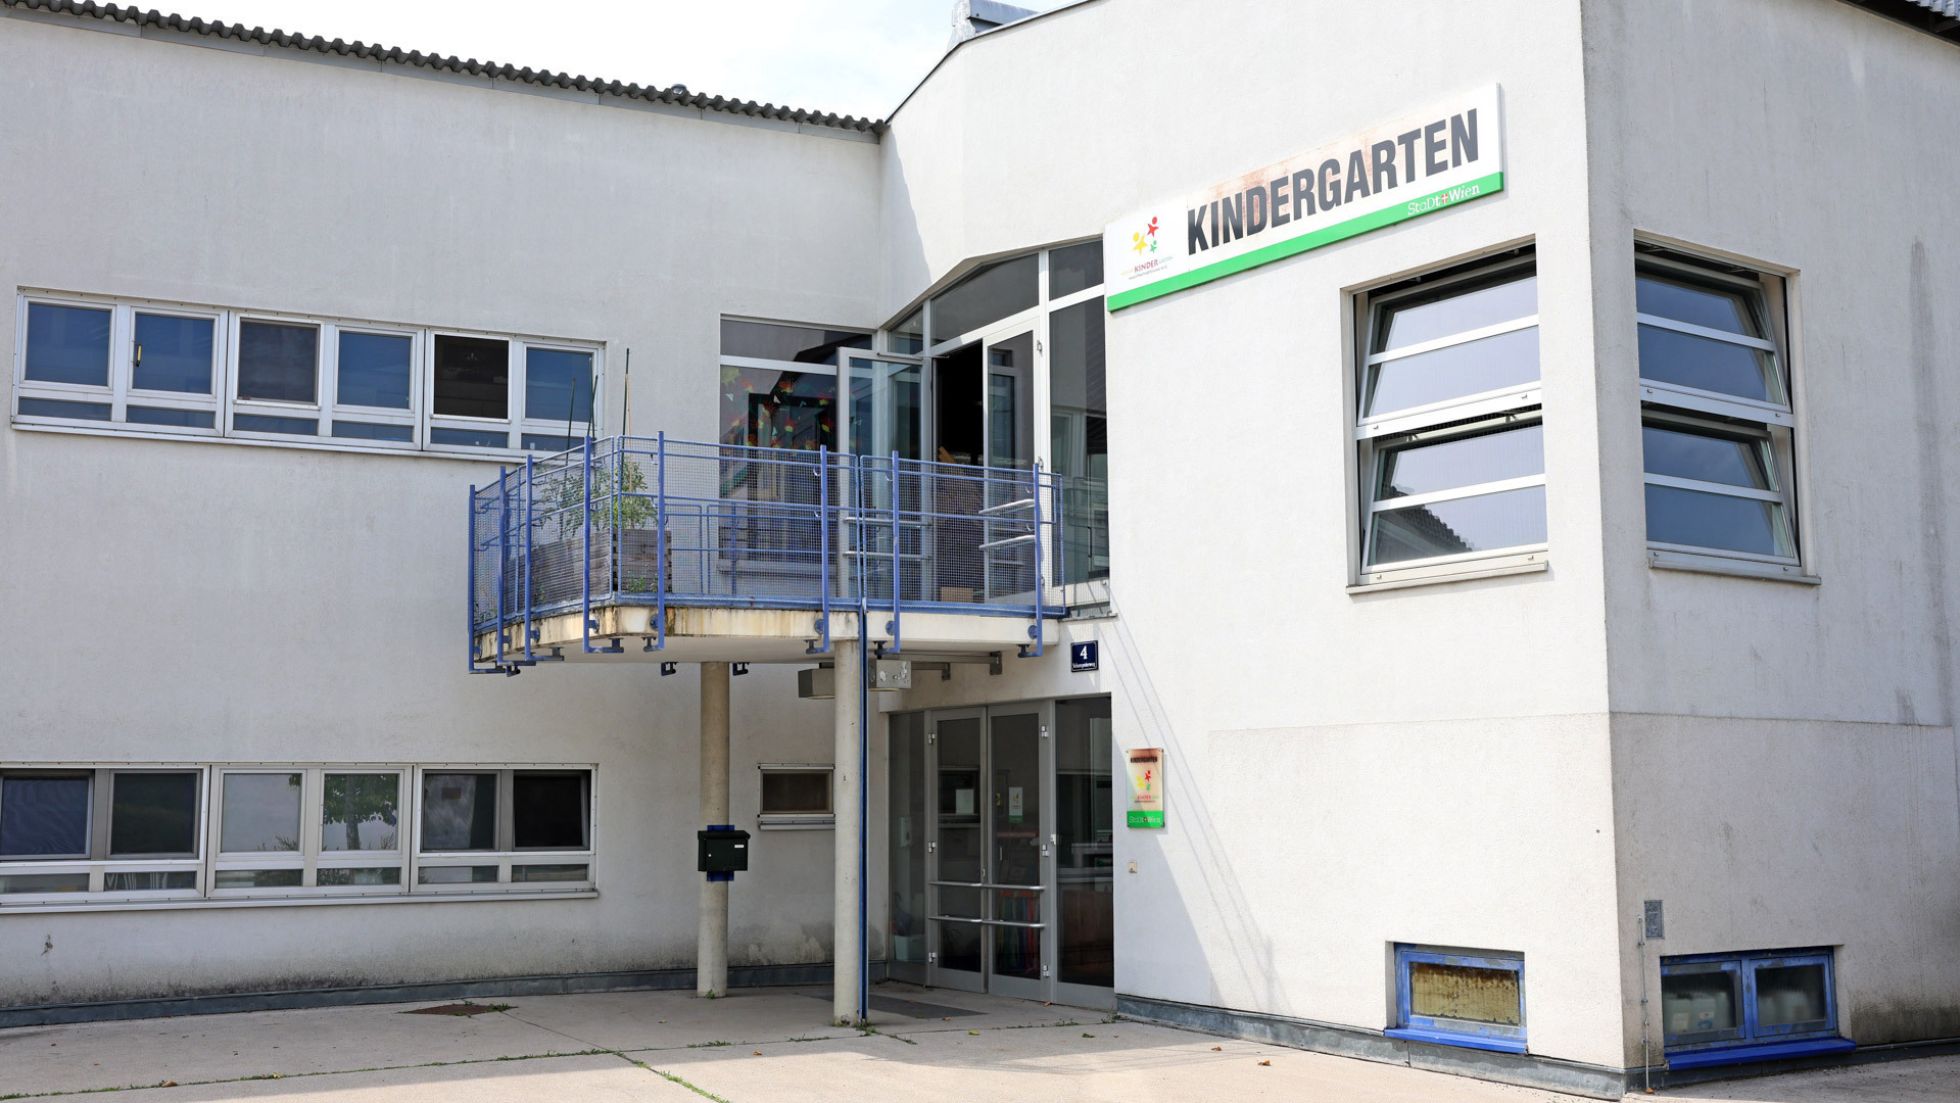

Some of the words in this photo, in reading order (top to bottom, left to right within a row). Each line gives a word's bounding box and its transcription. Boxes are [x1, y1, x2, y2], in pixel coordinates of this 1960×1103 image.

[1187, 108, 1479, 256] KINDERGARTEN
[1448, 184, 1480, 202] Wien
[1080, 645, 1088, 660] 4
